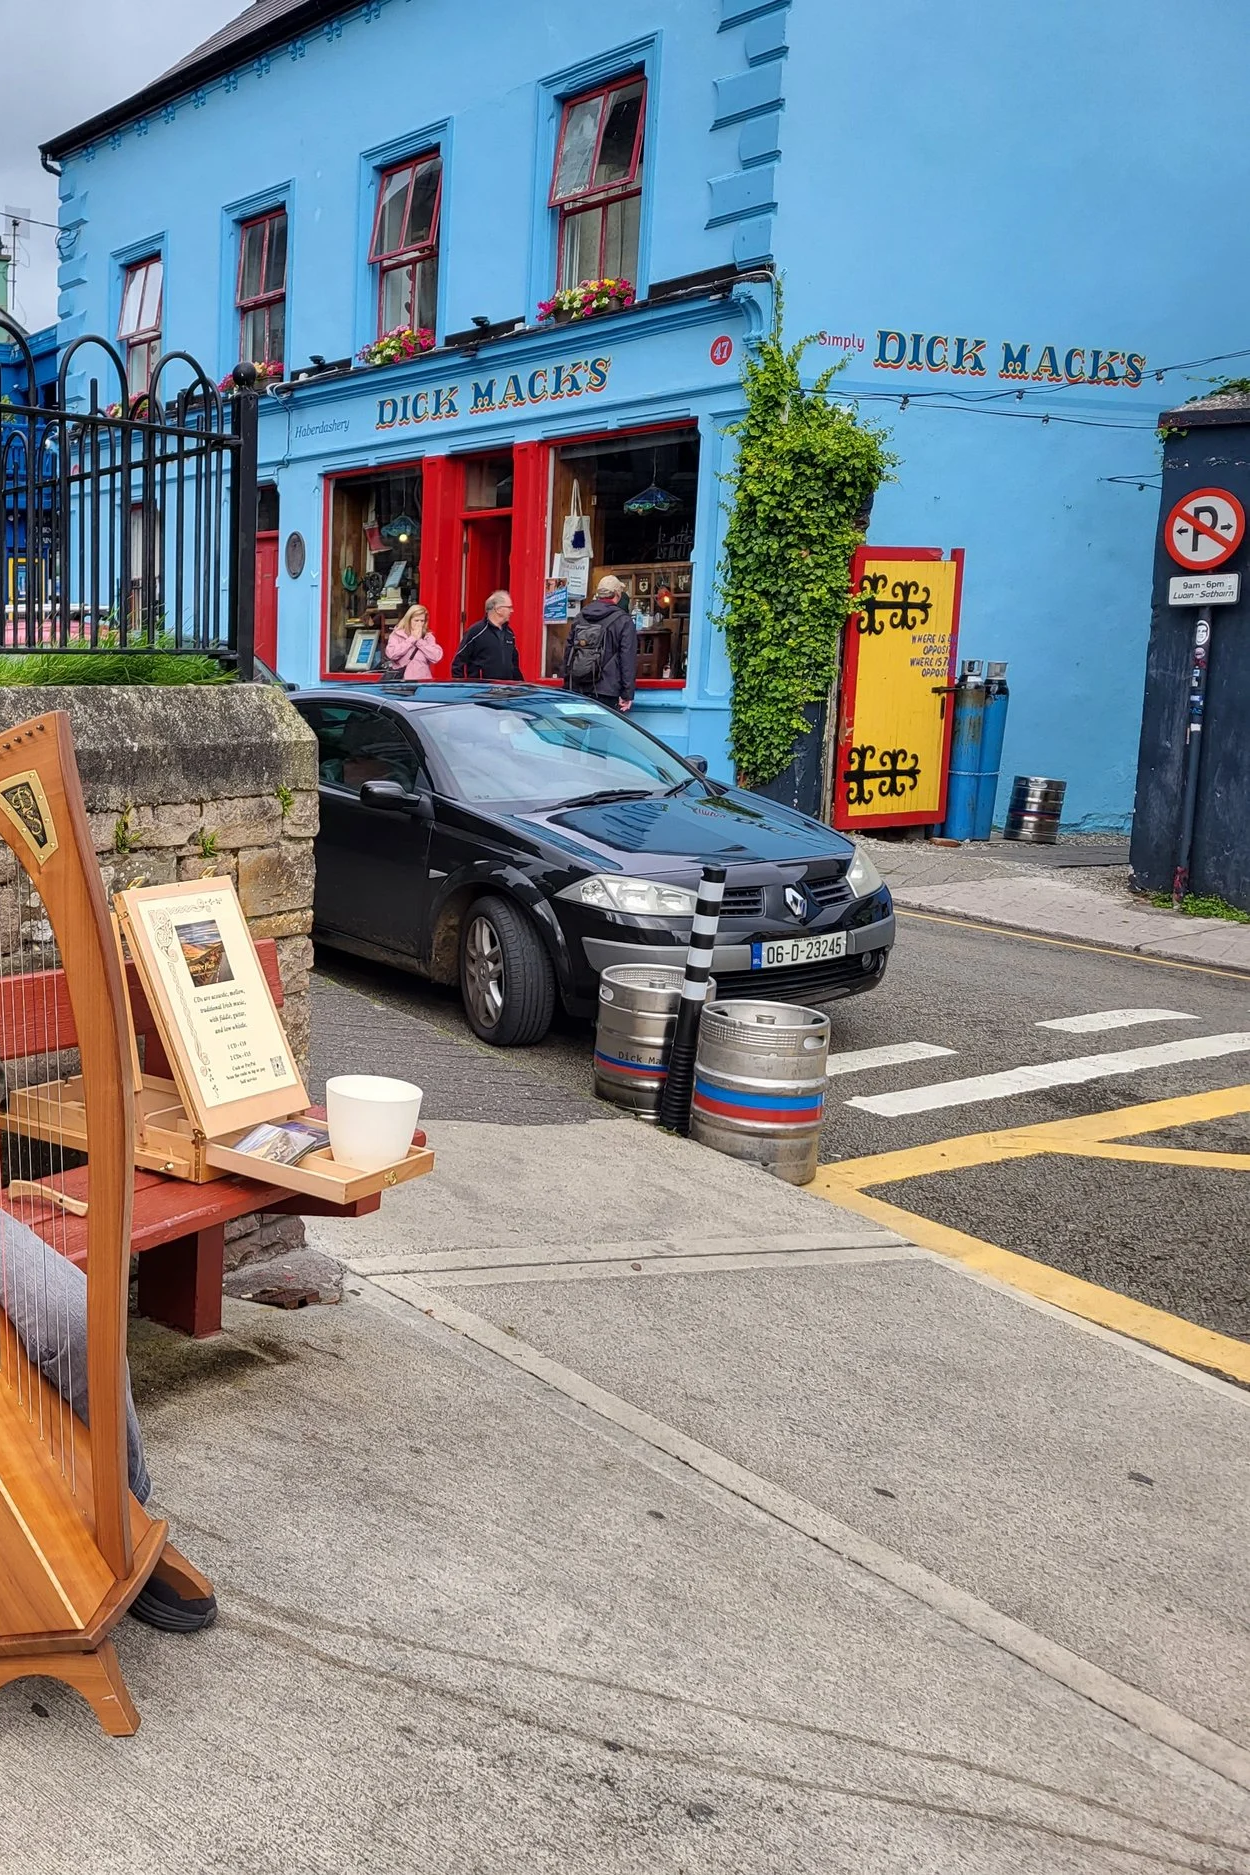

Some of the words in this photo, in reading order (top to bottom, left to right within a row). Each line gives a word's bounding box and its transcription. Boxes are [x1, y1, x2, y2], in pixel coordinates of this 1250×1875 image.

[713, 341, 730, 360] 47
[818, 330, 865, 352] Simply
[872, 328, 988, 377] DICK
[998, 341, 1147, 389] MACK'S
[375, 386, 460, 430] DICK
[469, 355, 612, 415] MACK'S
[295, 419, 350, 438] Haberdashery
[911, 633, 936, 644] WHERE
[937, 633, 946, 643] IS
[910, 657, 934, 667] WHERE
[934, 657, 942, 667] IS
[766, 937, 842, 964] 06-D-23245
[618, 1050, 643, 1063] Dick
[648, 1056, 662, 1065] Ma
